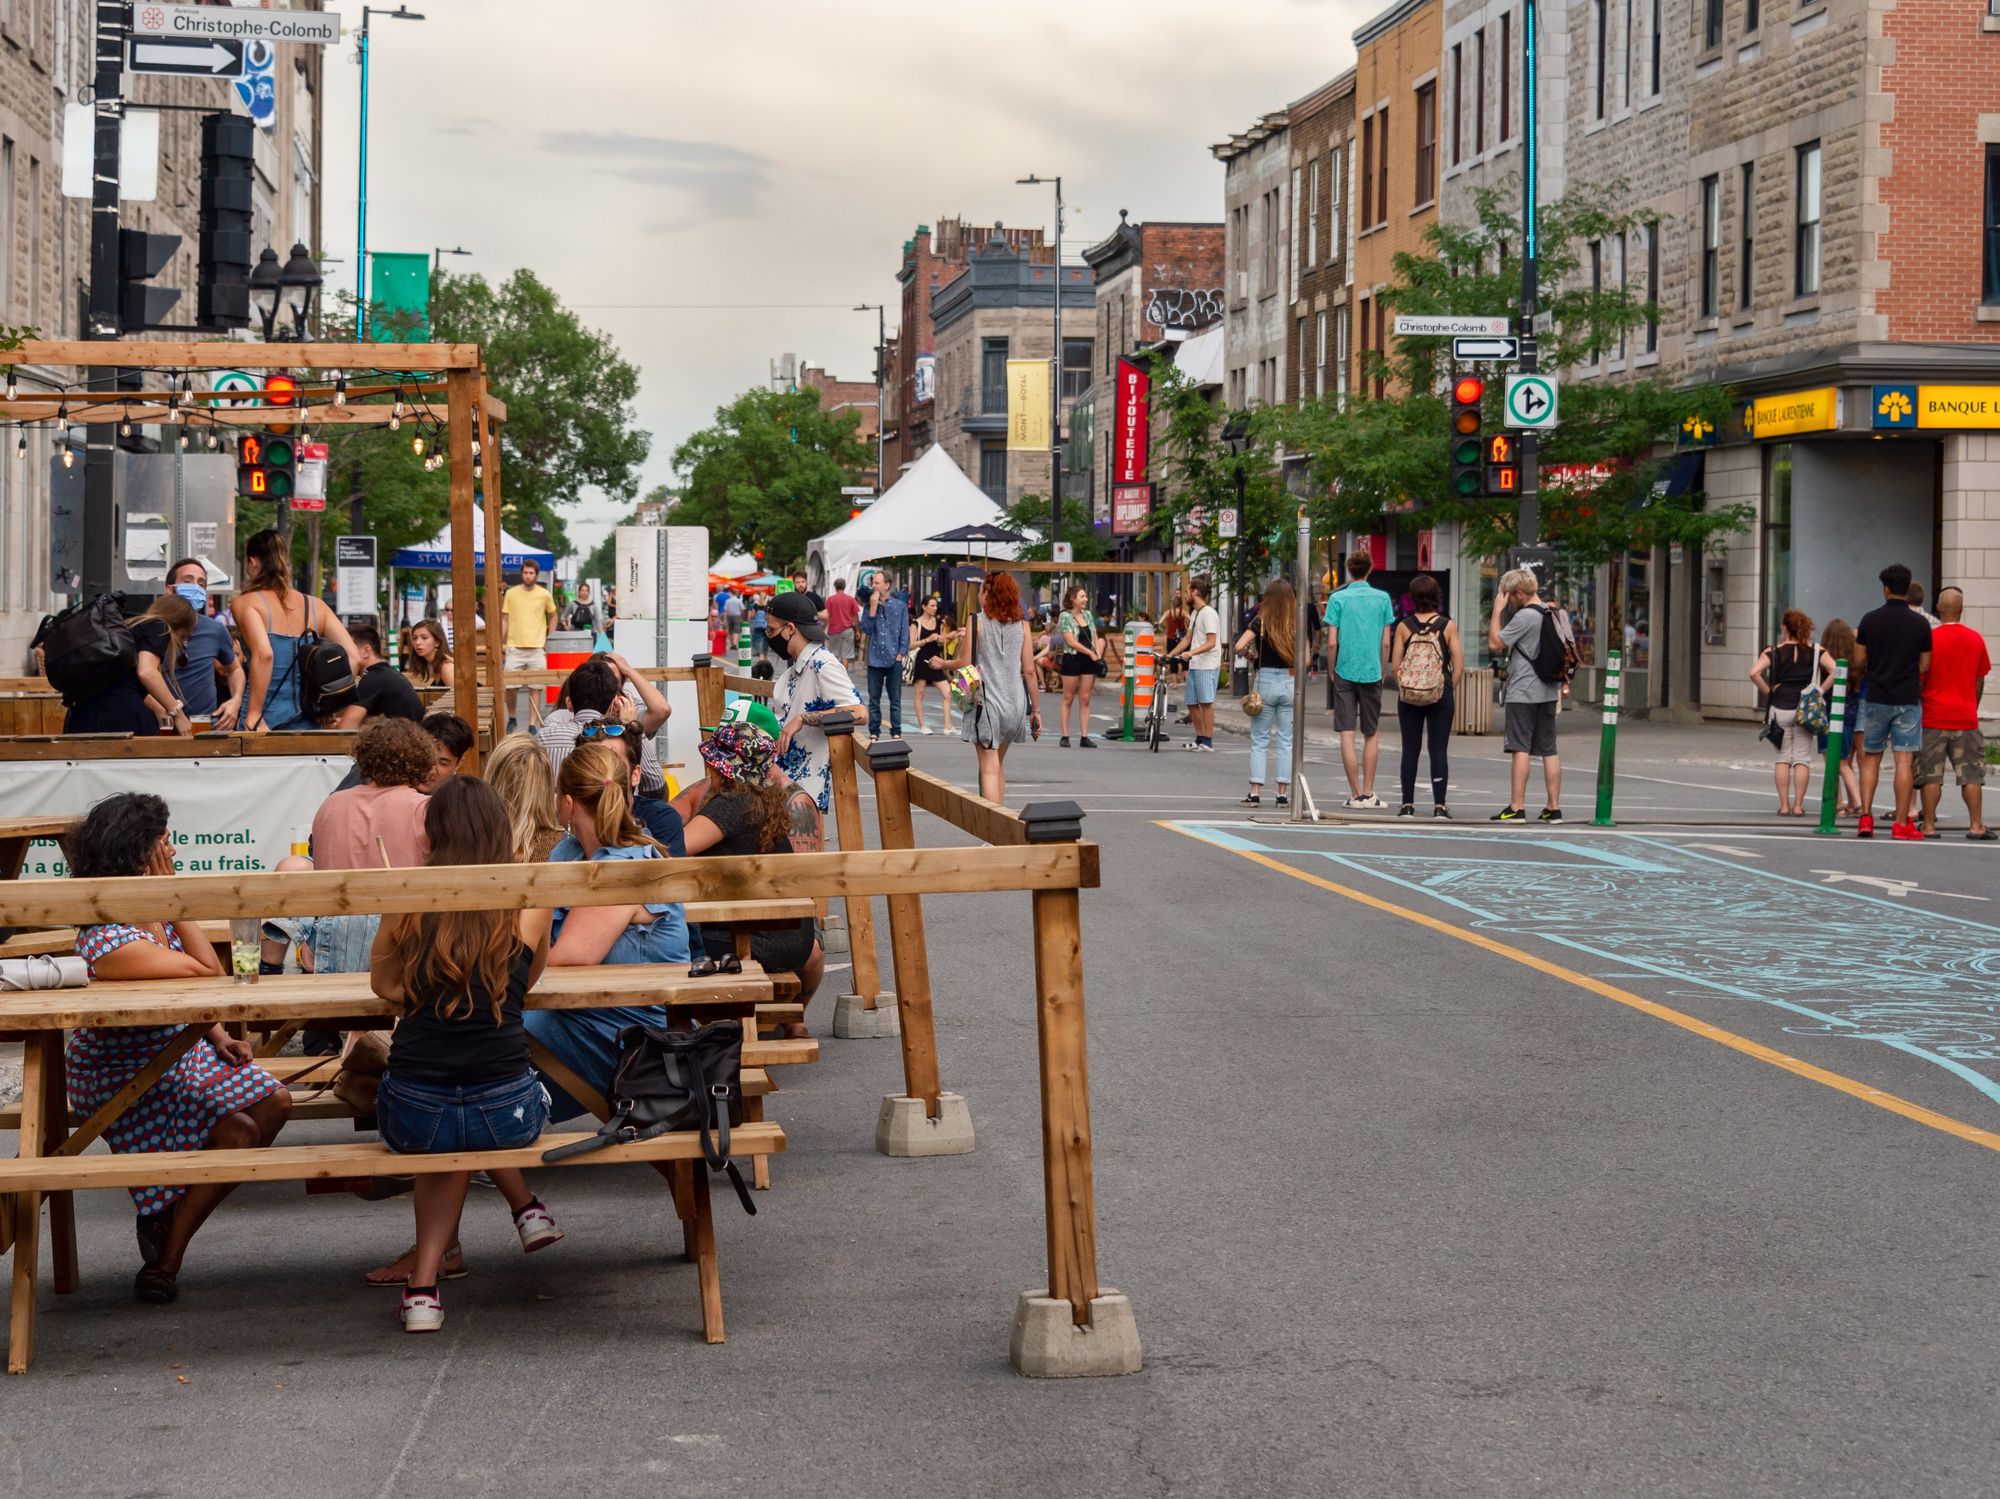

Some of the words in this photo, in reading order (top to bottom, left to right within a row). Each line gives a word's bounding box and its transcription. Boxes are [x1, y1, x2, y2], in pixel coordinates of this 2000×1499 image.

[173, 15, 333, 39] Christophe-Colomb
[1400, 322, 1487, 333] Christophe-Colomb
[1929, 401, 1987, 416] BANQUE
[1125, 374, 1137, 480] BIJOUTERIE
[173, 830, 189, 845] le
[195, 829, 256, 845] moral.
[189, 860, 213, 872] au
[218, 855, 266, 871] frais.
